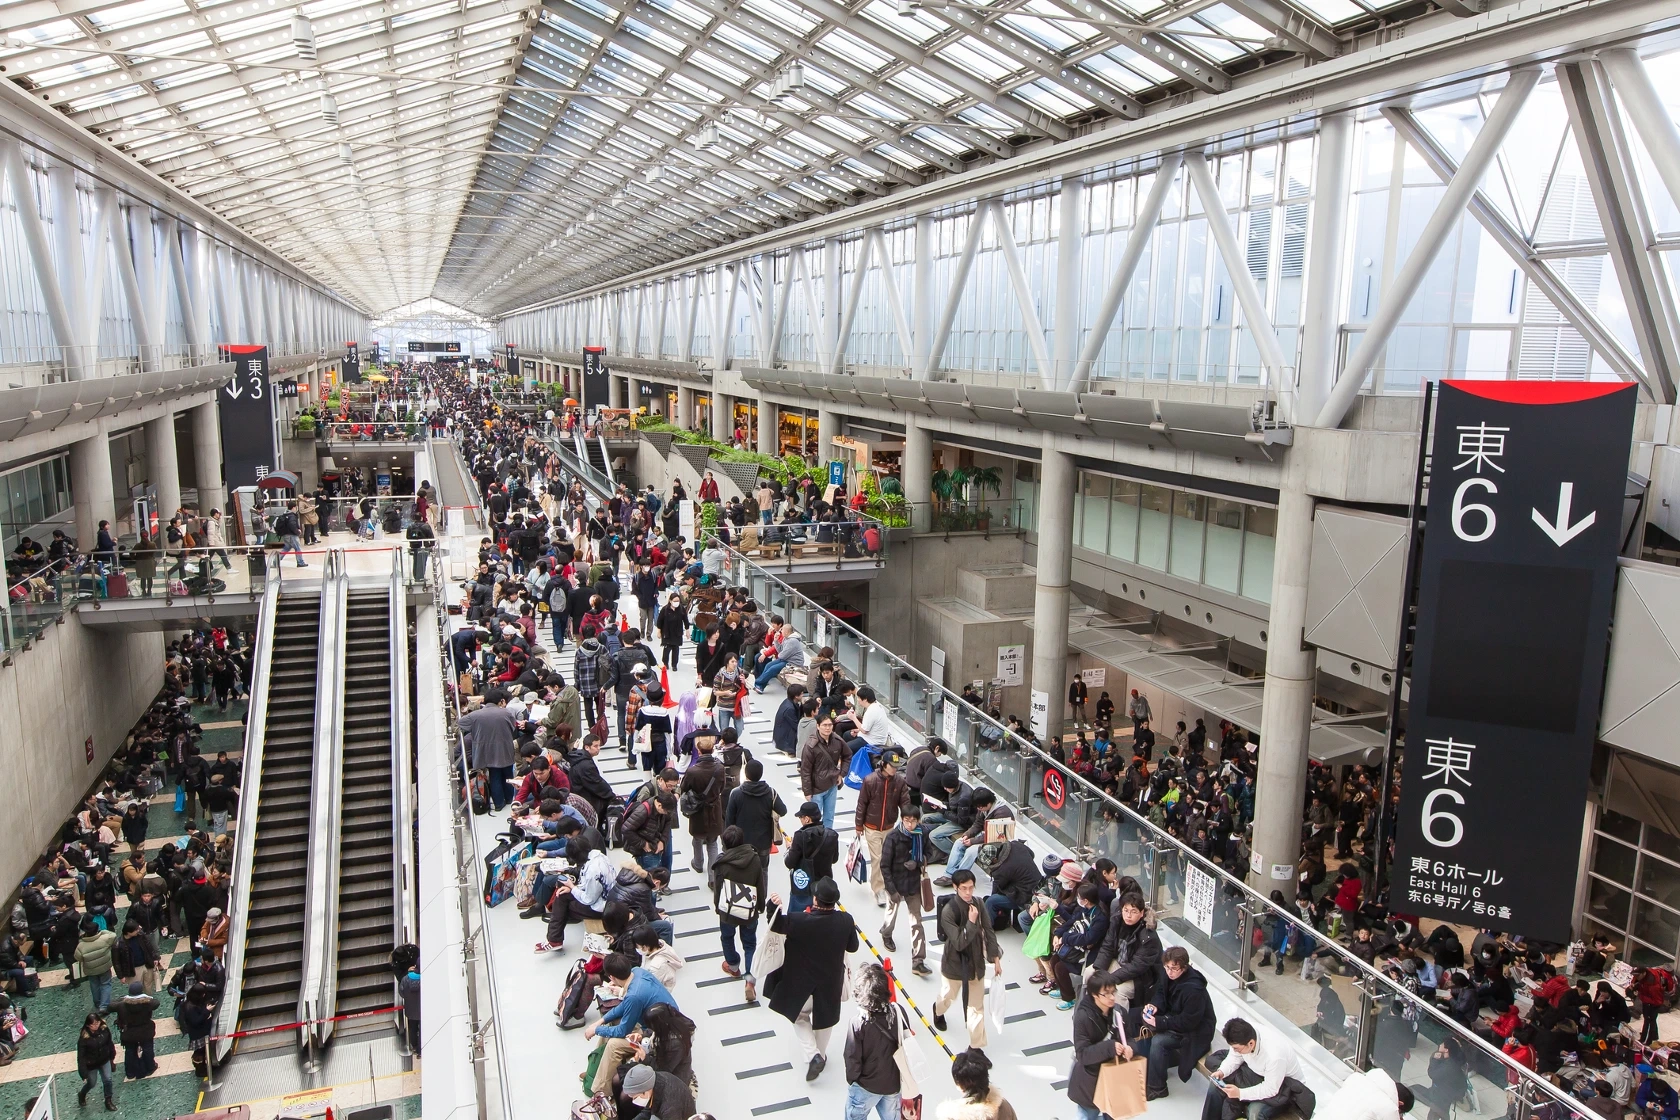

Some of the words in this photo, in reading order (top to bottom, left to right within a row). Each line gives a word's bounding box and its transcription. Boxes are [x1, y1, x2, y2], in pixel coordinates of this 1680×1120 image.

[248, 359, 263, 376] 東
[351, 354, 357, 363] 2
[586, 363, 593, 375] 5
[249, 377, 263, 399] 3
[1452, 422, 1511, 473] 東
[1450, 478, 1498, 542] 6
[1422, 737, 1476, 787] 東
[1420, 789, 1465, 848] 6
[1410, 856, 1504, 886] 東6ホール
[1409, 875, 1437, 891] East
[1441, 880, 1467, 896] Hall
[1472, 886, 1482, 899] 6
